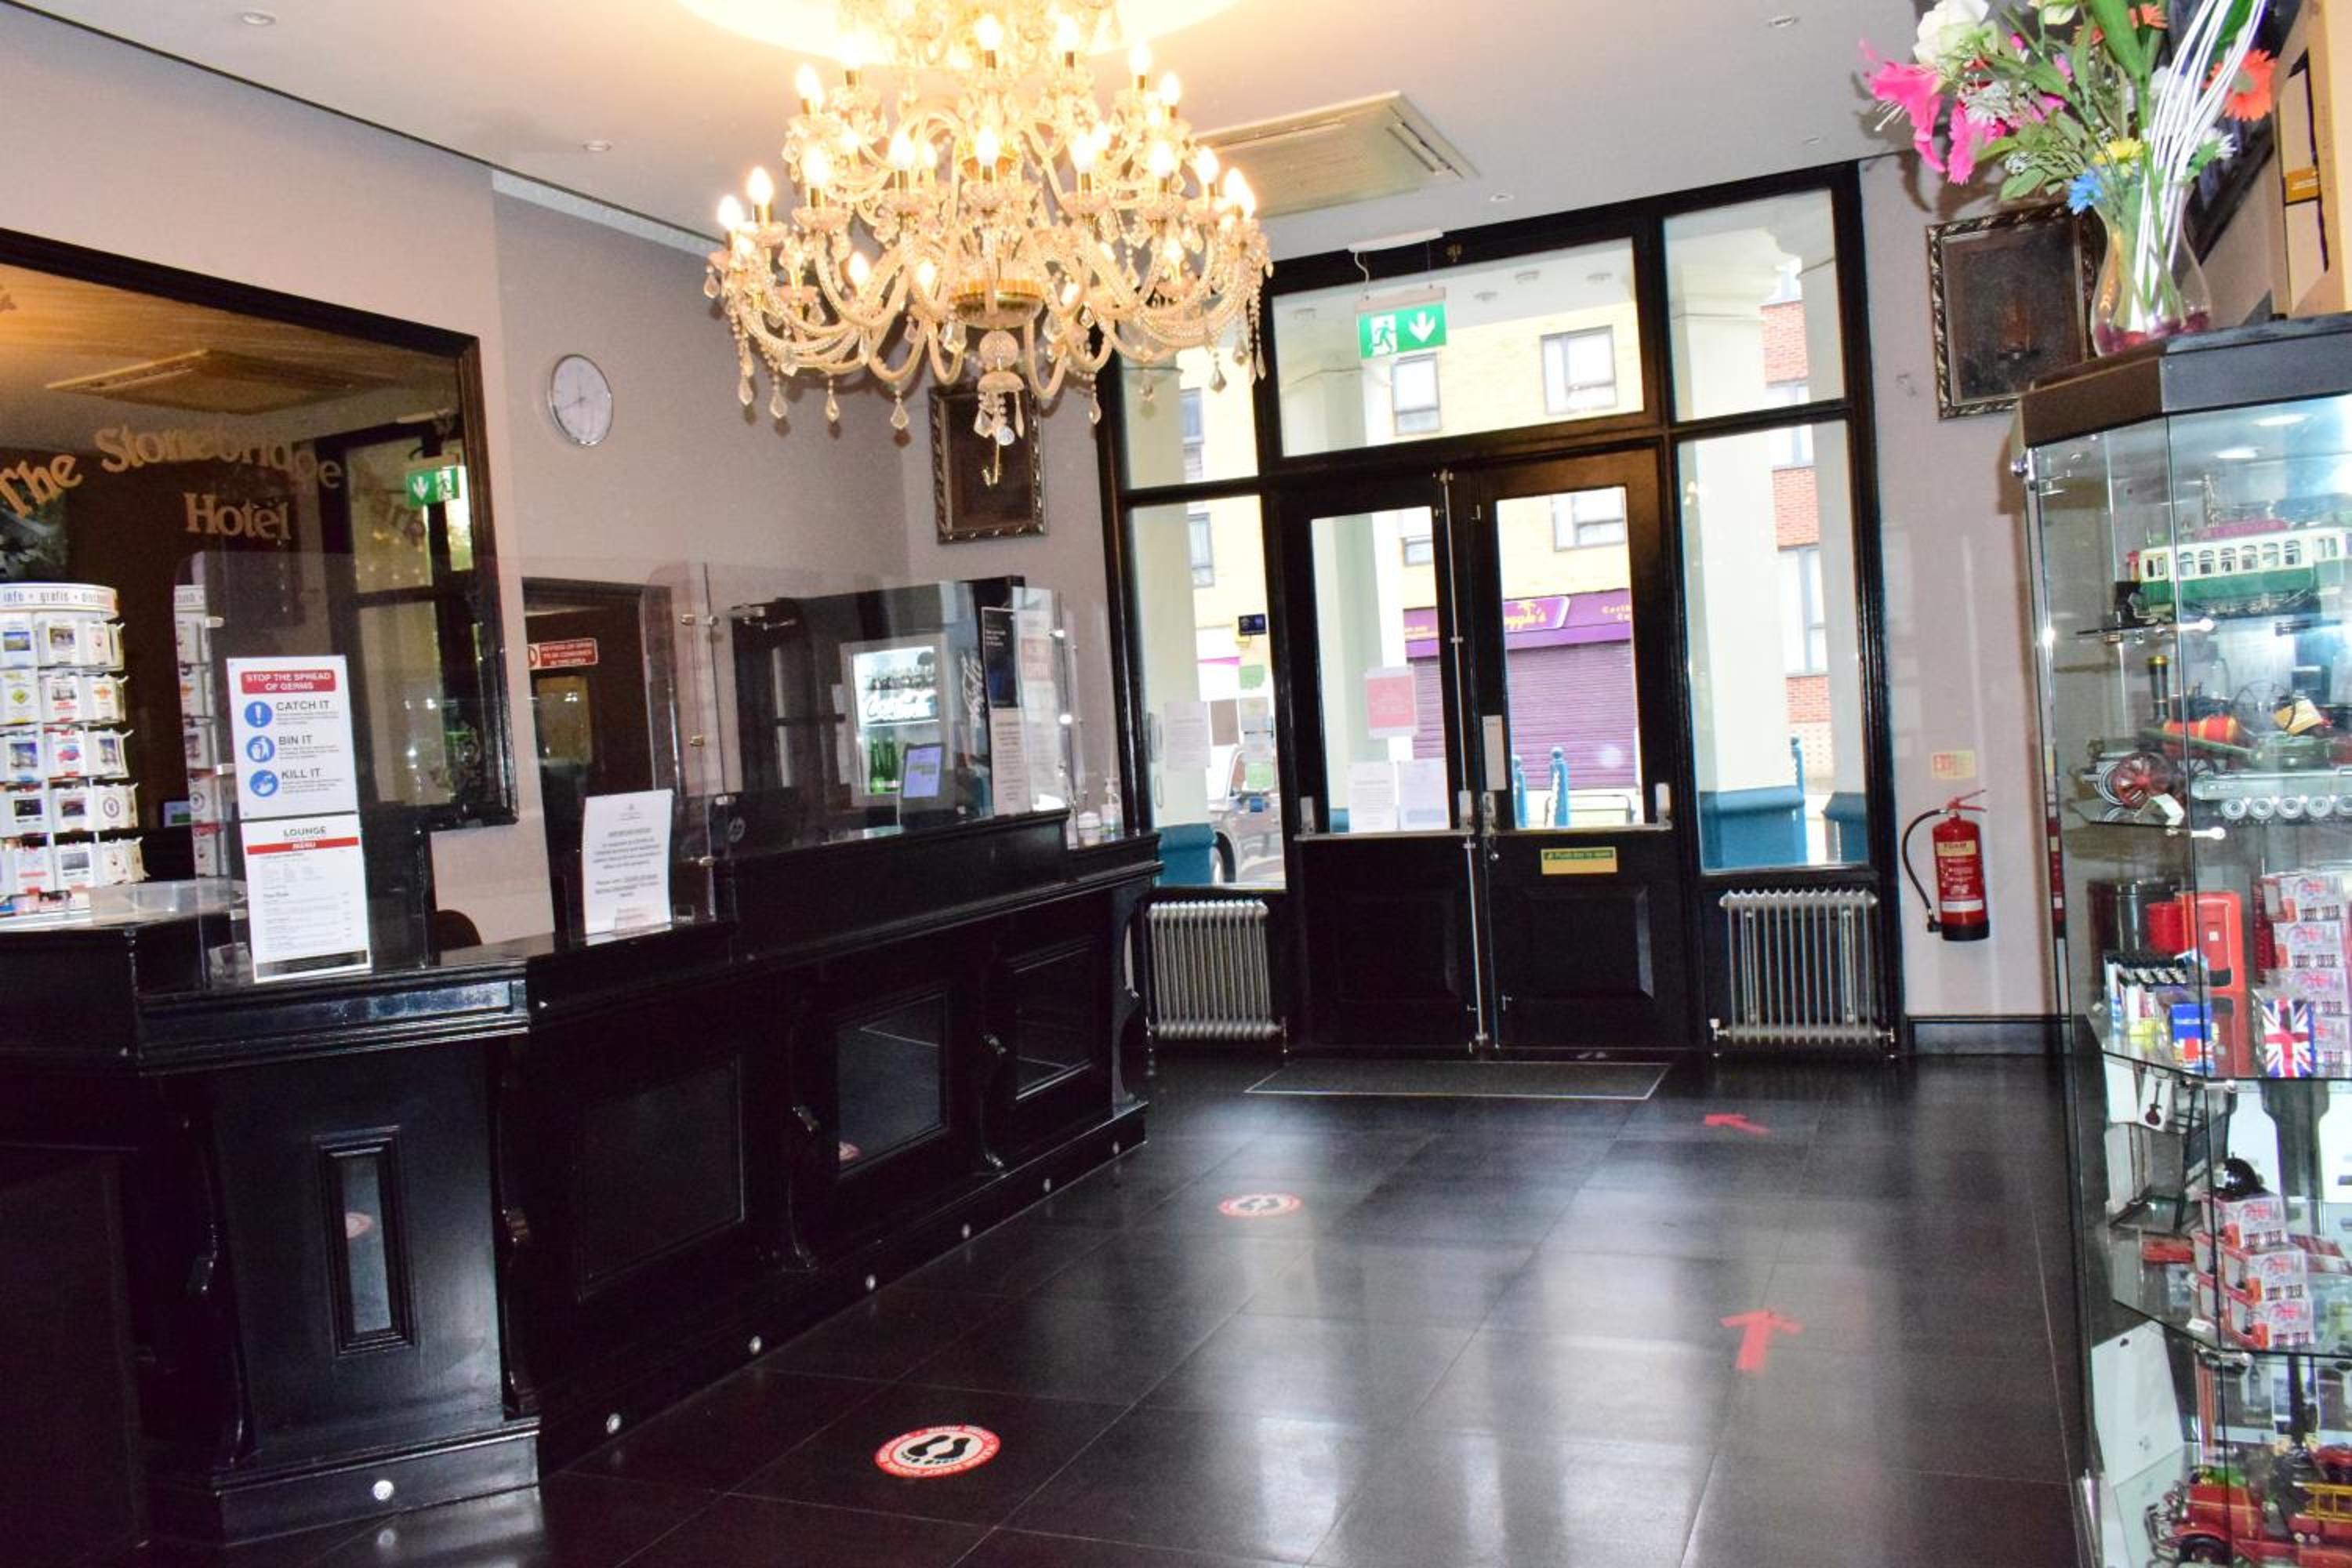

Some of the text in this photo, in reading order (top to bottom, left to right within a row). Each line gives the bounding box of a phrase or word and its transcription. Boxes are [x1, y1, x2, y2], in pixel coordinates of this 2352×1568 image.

[183, 492, 292, 540] Hotel
[245, 671, 332, 682] STOP THE SPREAD
[265, 681, 314, 691] OF GERMS
[276, 700, 330, 711] CATCH IT
[278, 735, 313, 745] BIN IT
[282, 768, 321, 779] KILL IT
[283, 826, 327, 837] LOUNGE
